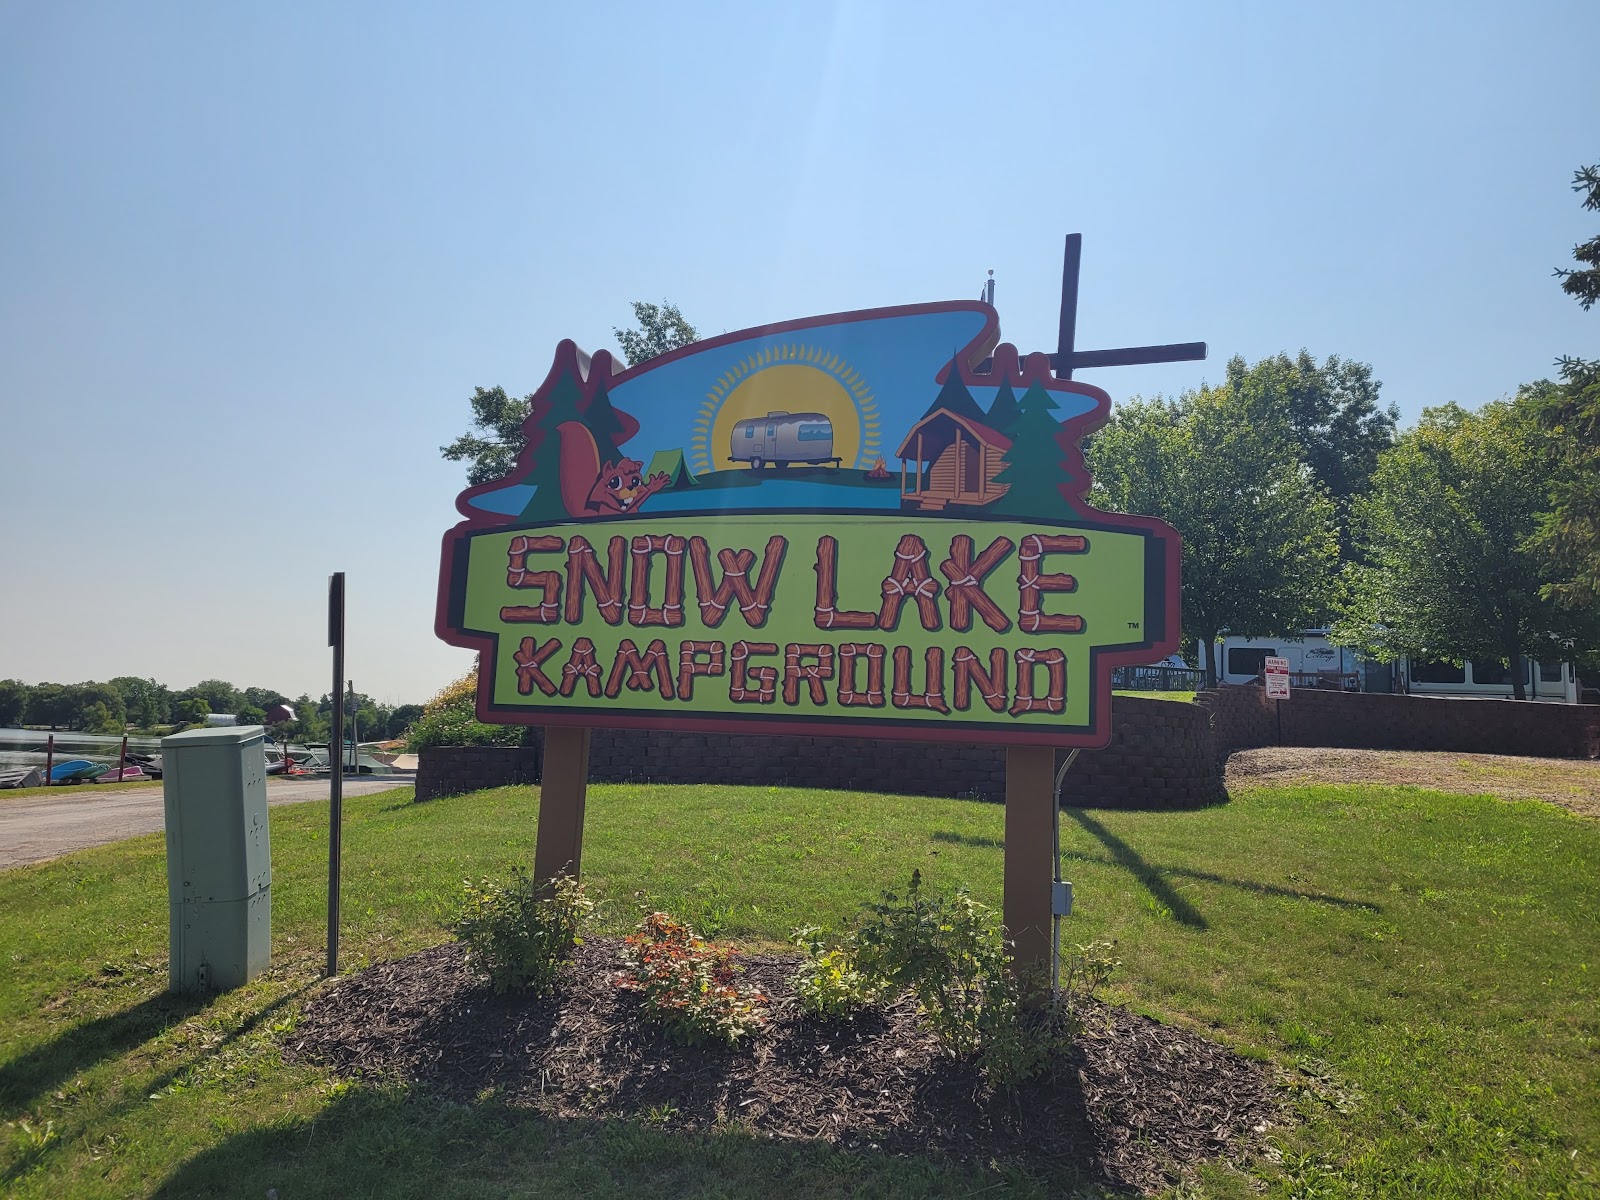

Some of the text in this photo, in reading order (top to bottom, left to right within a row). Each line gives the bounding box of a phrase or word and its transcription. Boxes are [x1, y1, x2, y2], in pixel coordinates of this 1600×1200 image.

[499, 533, 1090, 634] SNOW LAKE
[512, 636, 1067, 717] KAMPGROUND
